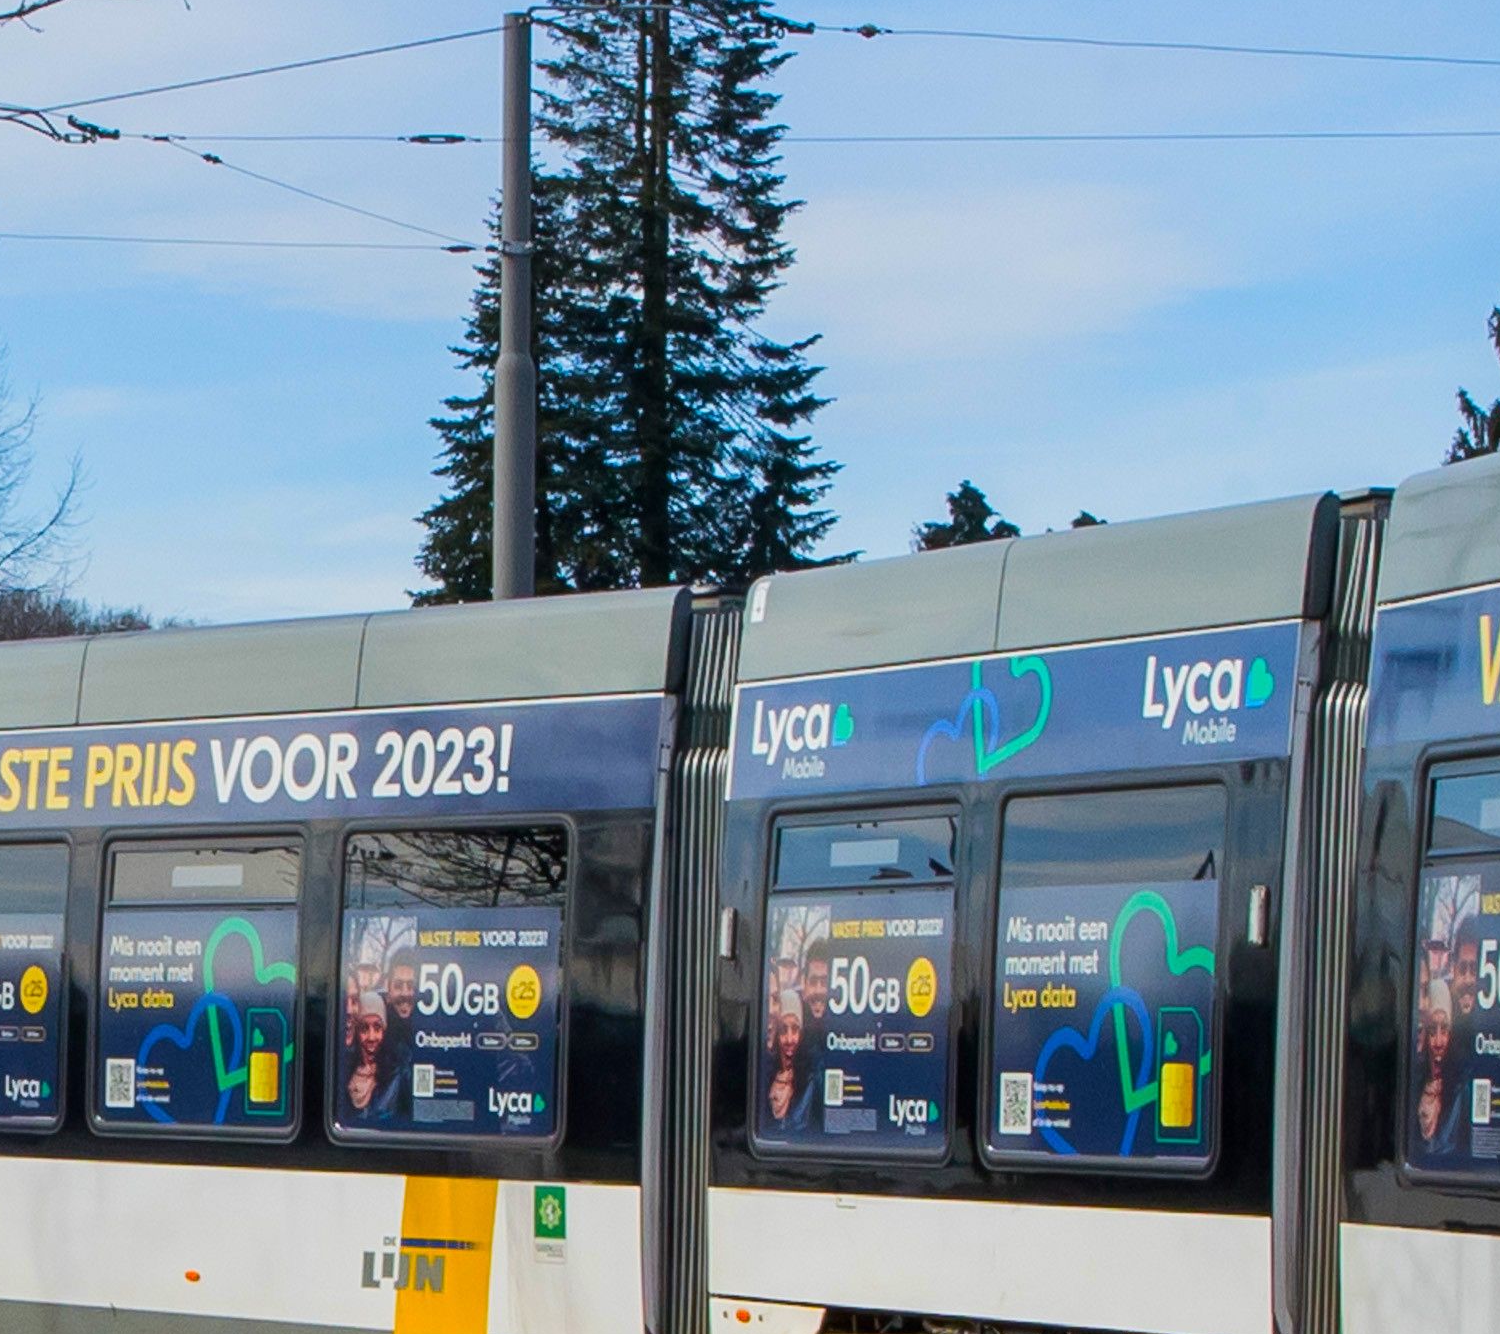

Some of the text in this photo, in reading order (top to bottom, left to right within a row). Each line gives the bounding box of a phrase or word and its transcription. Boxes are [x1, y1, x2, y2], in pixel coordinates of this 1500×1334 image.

[1143, 655, 1243, 729] Lyca
[752, 700, 831, 766] Lyca
[1182, 717, 1237, 745] Mobile
[84, 740, 196, 810] PRIJS
[210, 732, 360, 803] VOOR
[373, 724, 513, 798] 2023!
[782, 755, 826, 780] Mobile
[482, 931, 516, 946] VOOR
[1006, 916, 1108, 943] Mis nooit een
[110, 935, 201, 956] Mis nooit een
[108, 962, 194, 983] moment met
[1005, 949, 1099, 975] moment met
[417, 963, 499, 1016] 50GB
[829, 956, 900, 1014] 50GB
[1003, 982, 1077, 1014] Lyca data
[108, 988, 174, 1012] Lyca data
[5, 1075, 40, 1101] Lyca
[488, 1087, 531, 1116] Lyca
[889, 1094, 927, 1127] Lyca
